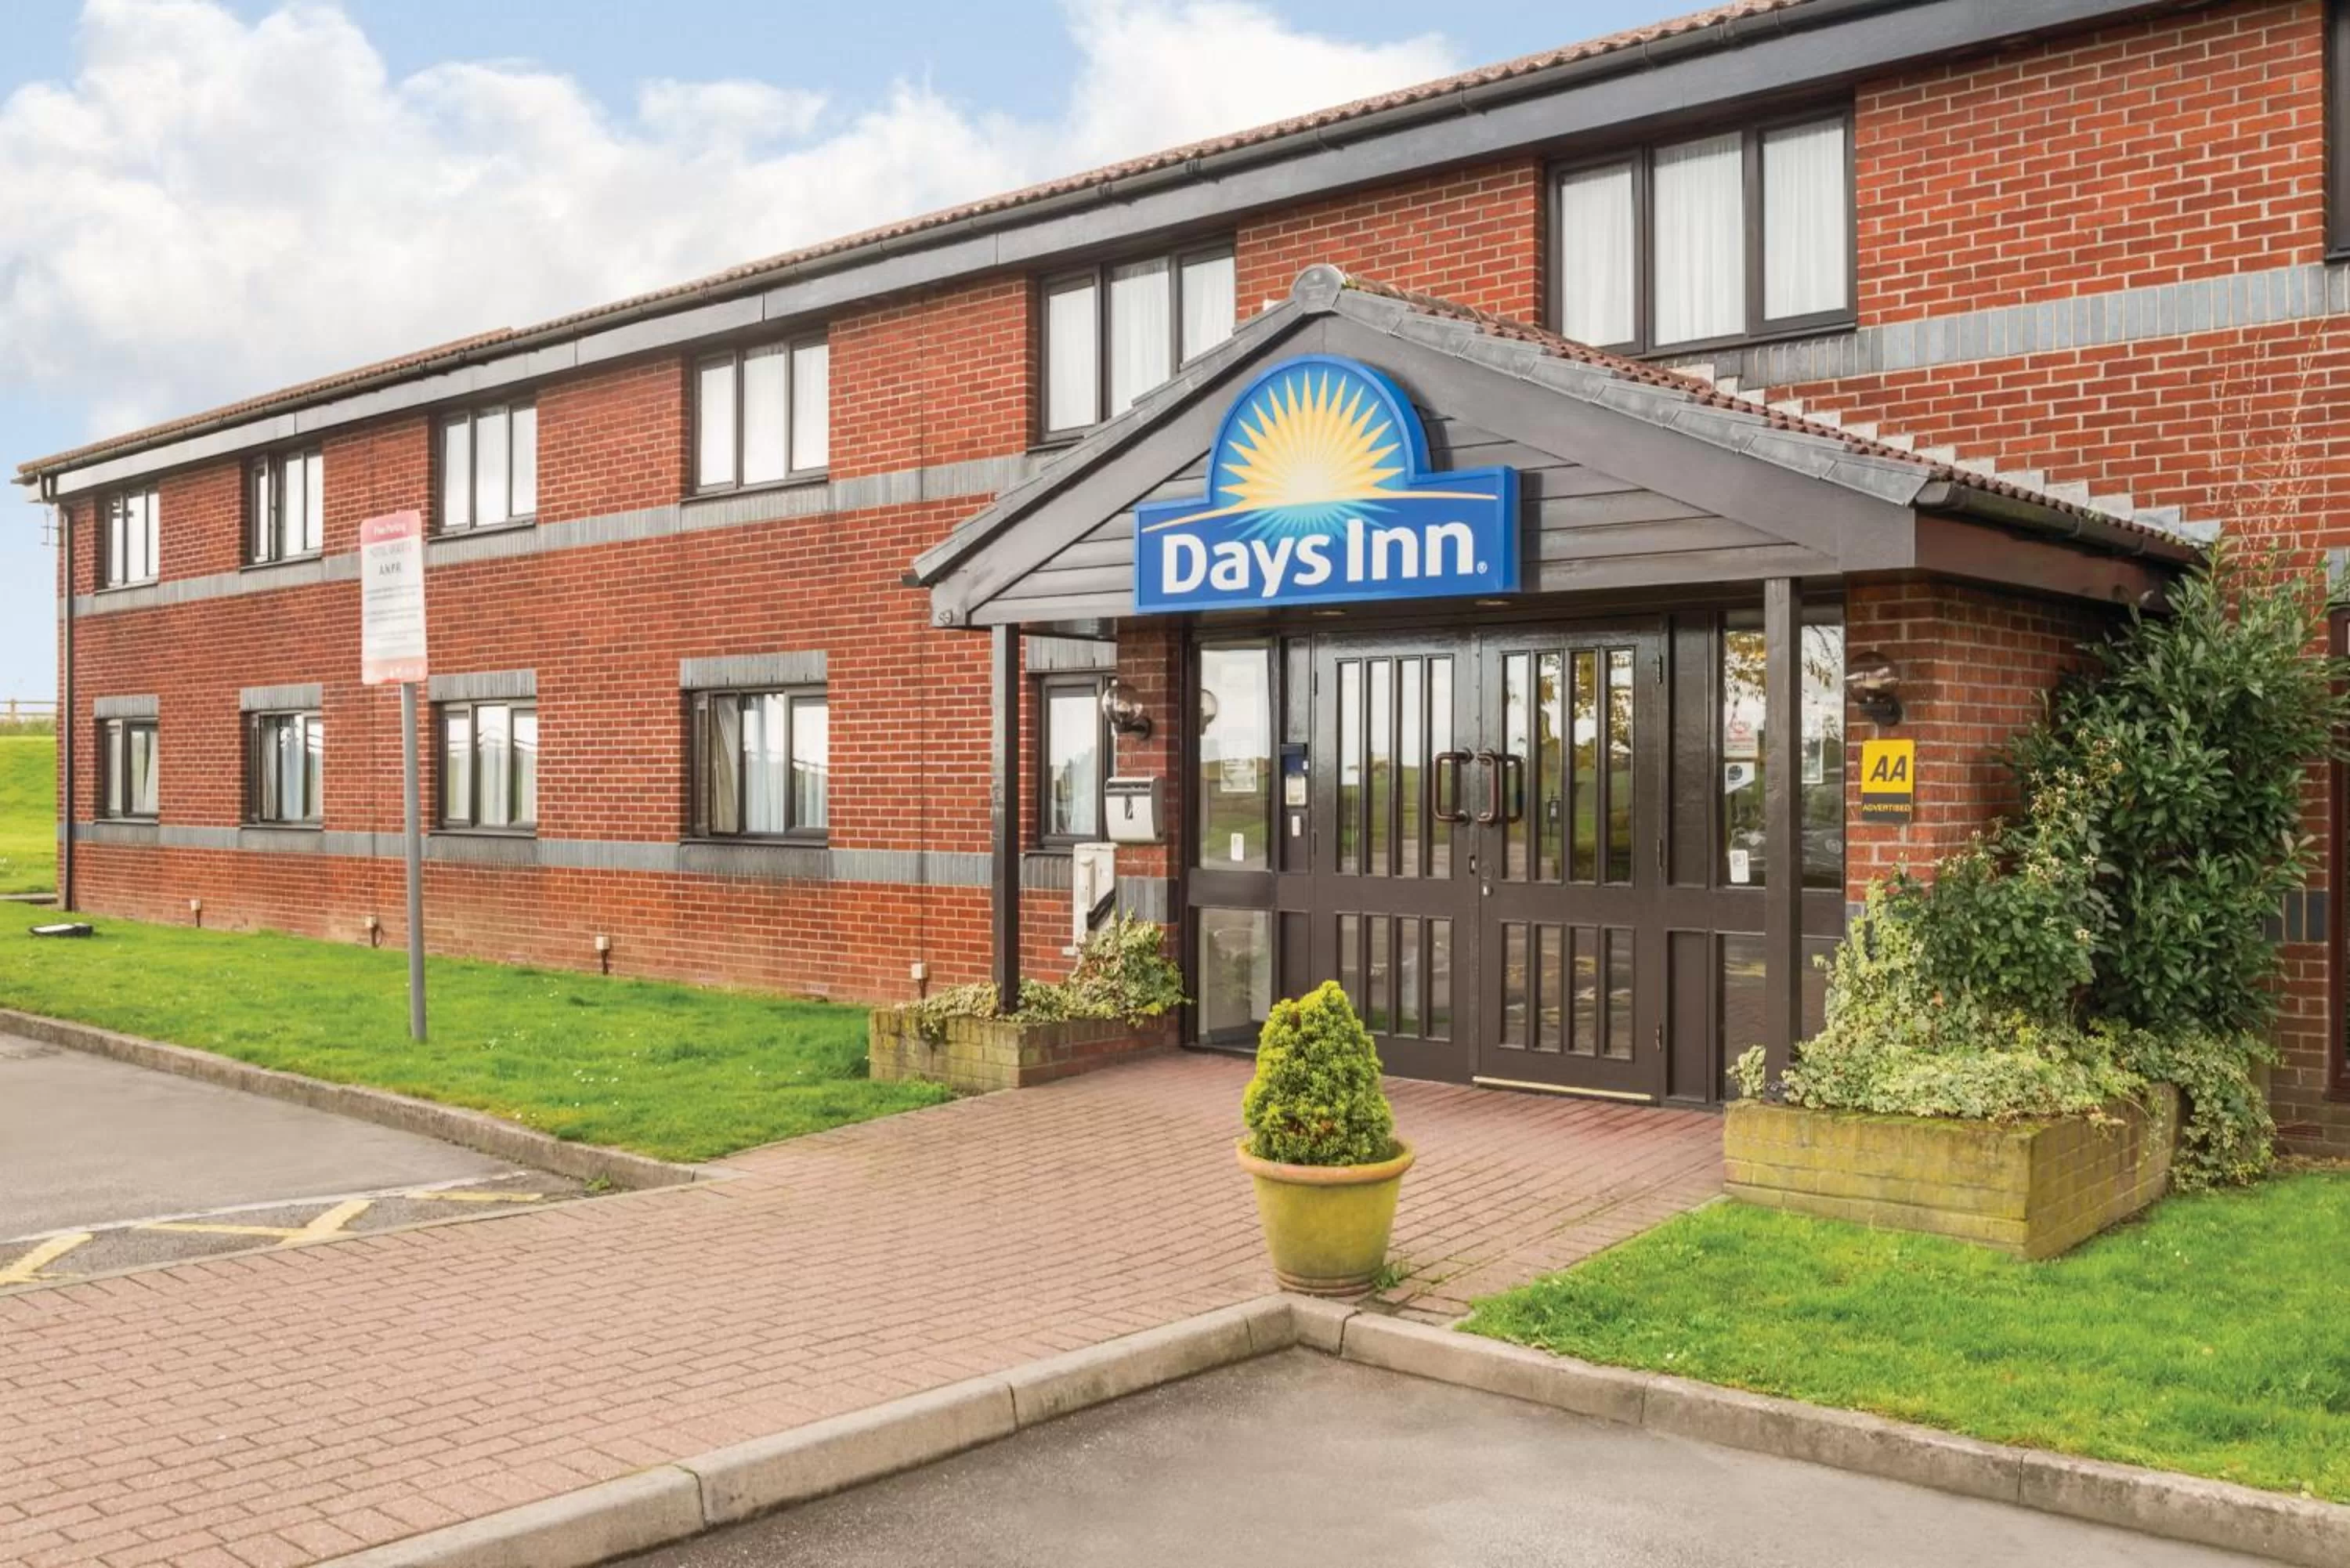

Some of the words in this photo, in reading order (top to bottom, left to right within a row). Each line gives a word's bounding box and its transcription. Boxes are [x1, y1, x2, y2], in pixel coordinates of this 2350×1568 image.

[1162, 534, 1332, 598] Days
[1347, 518, 1474, 583] Inn
[1869, 754, 1907, 782] AA
